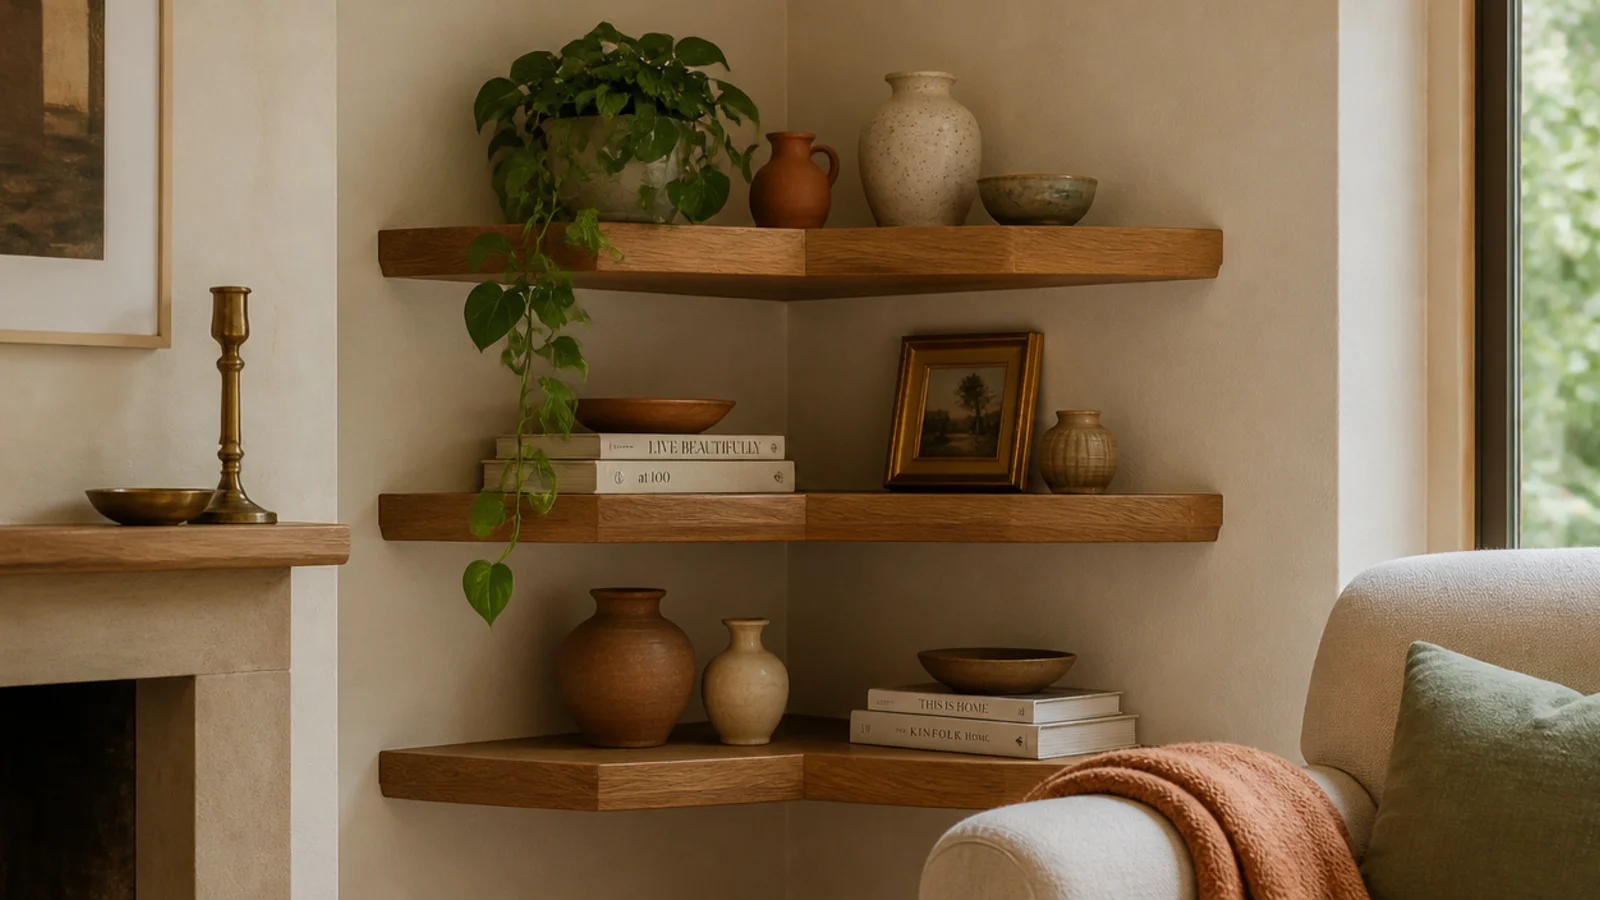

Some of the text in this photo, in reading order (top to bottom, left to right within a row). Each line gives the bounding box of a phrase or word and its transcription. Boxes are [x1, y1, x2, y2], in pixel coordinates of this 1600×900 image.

[648, 440, 678, 455] LIVE
[681, 440, 761, 455] BEAUTIFULLY
[638, 471, 671, 483] at 100
[918, 698, 989, 714] THIS IS HOME
[910, 727, 962, 741] KINFOLK
